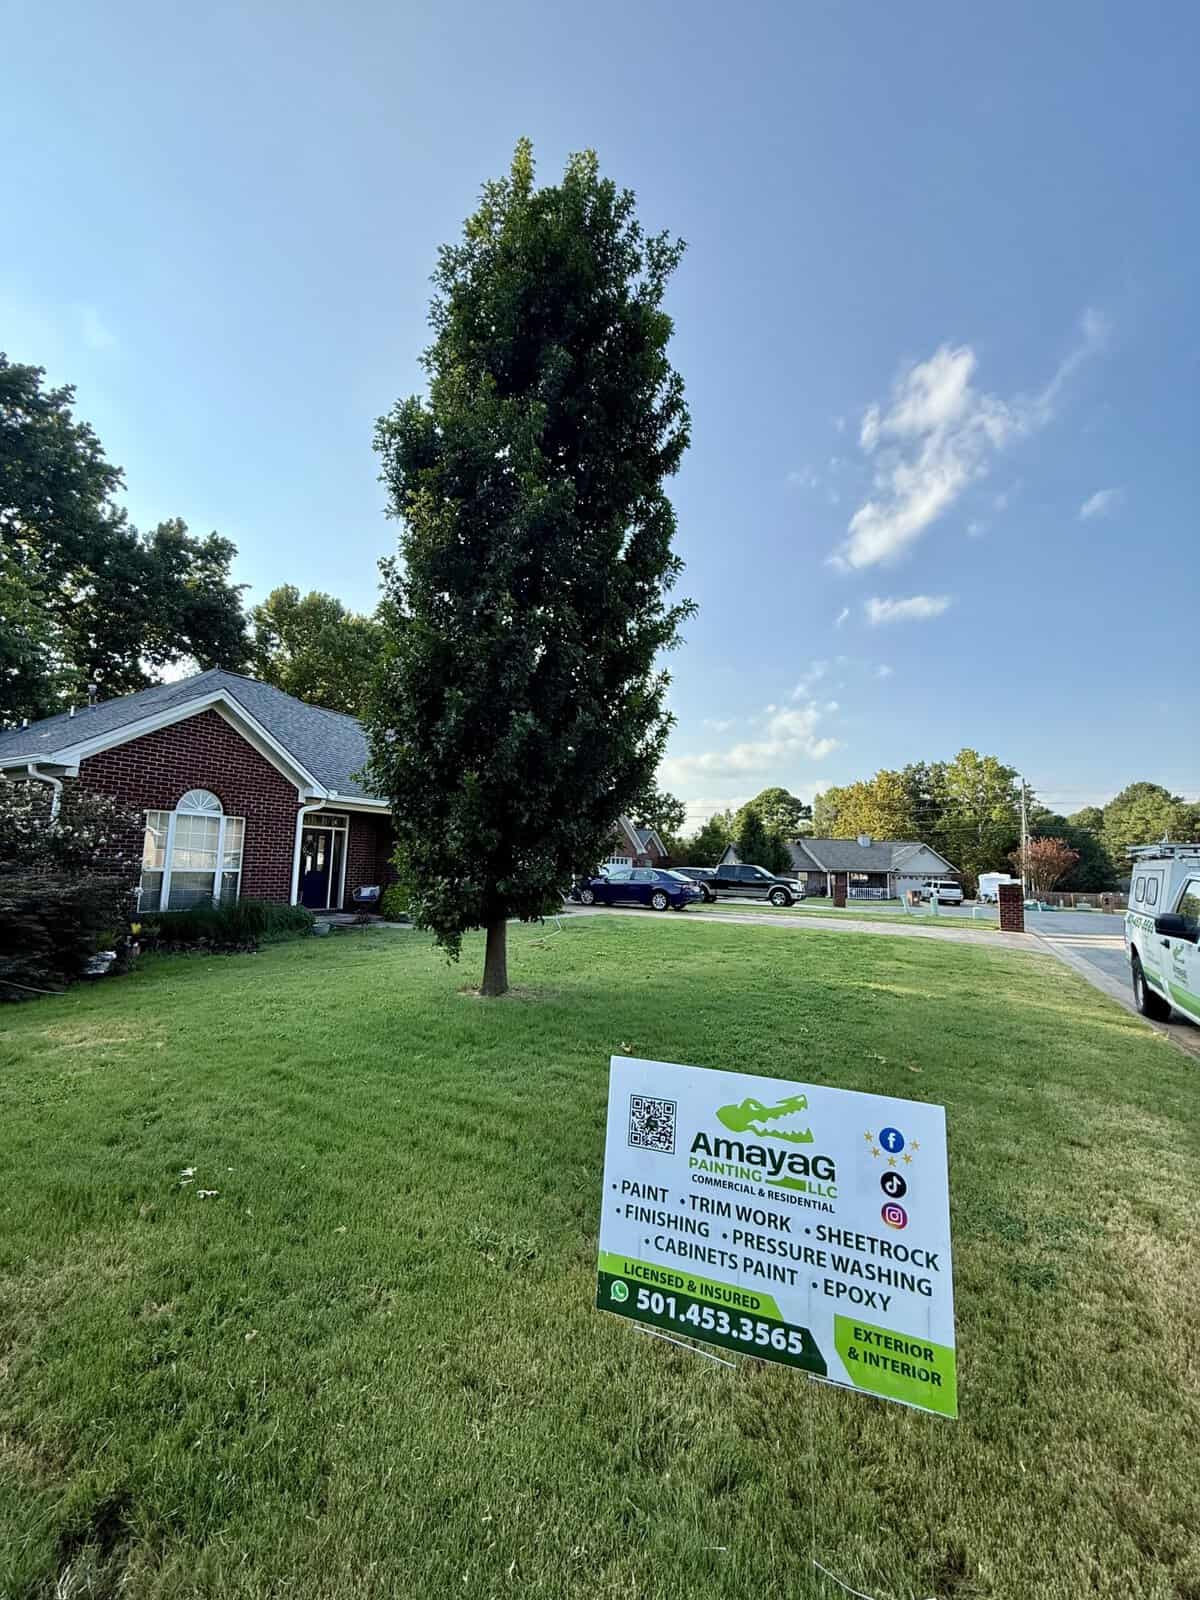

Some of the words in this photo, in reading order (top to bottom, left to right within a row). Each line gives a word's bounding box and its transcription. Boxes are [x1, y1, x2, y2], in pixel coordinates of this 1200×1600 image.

[689, 1157, 762, 1182] PAINTING
[808, 1181, 838, 1199] LLC
[692, 1174, 756, 1196] COMMERCIAL
[757, 1188, 765, 1198] &
[767, 1190, 835, 1214] RESIDENTIAL
[621, 1180, 669, 1203] PAINT
[689, 1195, 731, 1219] TRIM
[735, 1204, 792, 1233] WORK
[816, 1224, 940, 1272] SHEETROCK
[625, 1204, 709, 1238] FINISHING
[732, 1229, 827, 1268] PRESSURE
[831, 1253, 932, 1297] WASHING
[624, 1262, 684, 1289] LICENSED
[687, 1279, 697, 1293] &
[700, 1284, 760, 1311] INSURED
[654, 1235, 738, 1270] CABINETS
[743, 1257, 798, 1286] PAINT
[823, 1278, 891, 1312] EPOXY
[636, 1287, 803, 1355] 501.453.3565
[853, 1327, 934, 1362] EXTERIOR
[847, 1346, 859, 1361] &
[863, 1350, 942, 1387] INTERIOR
